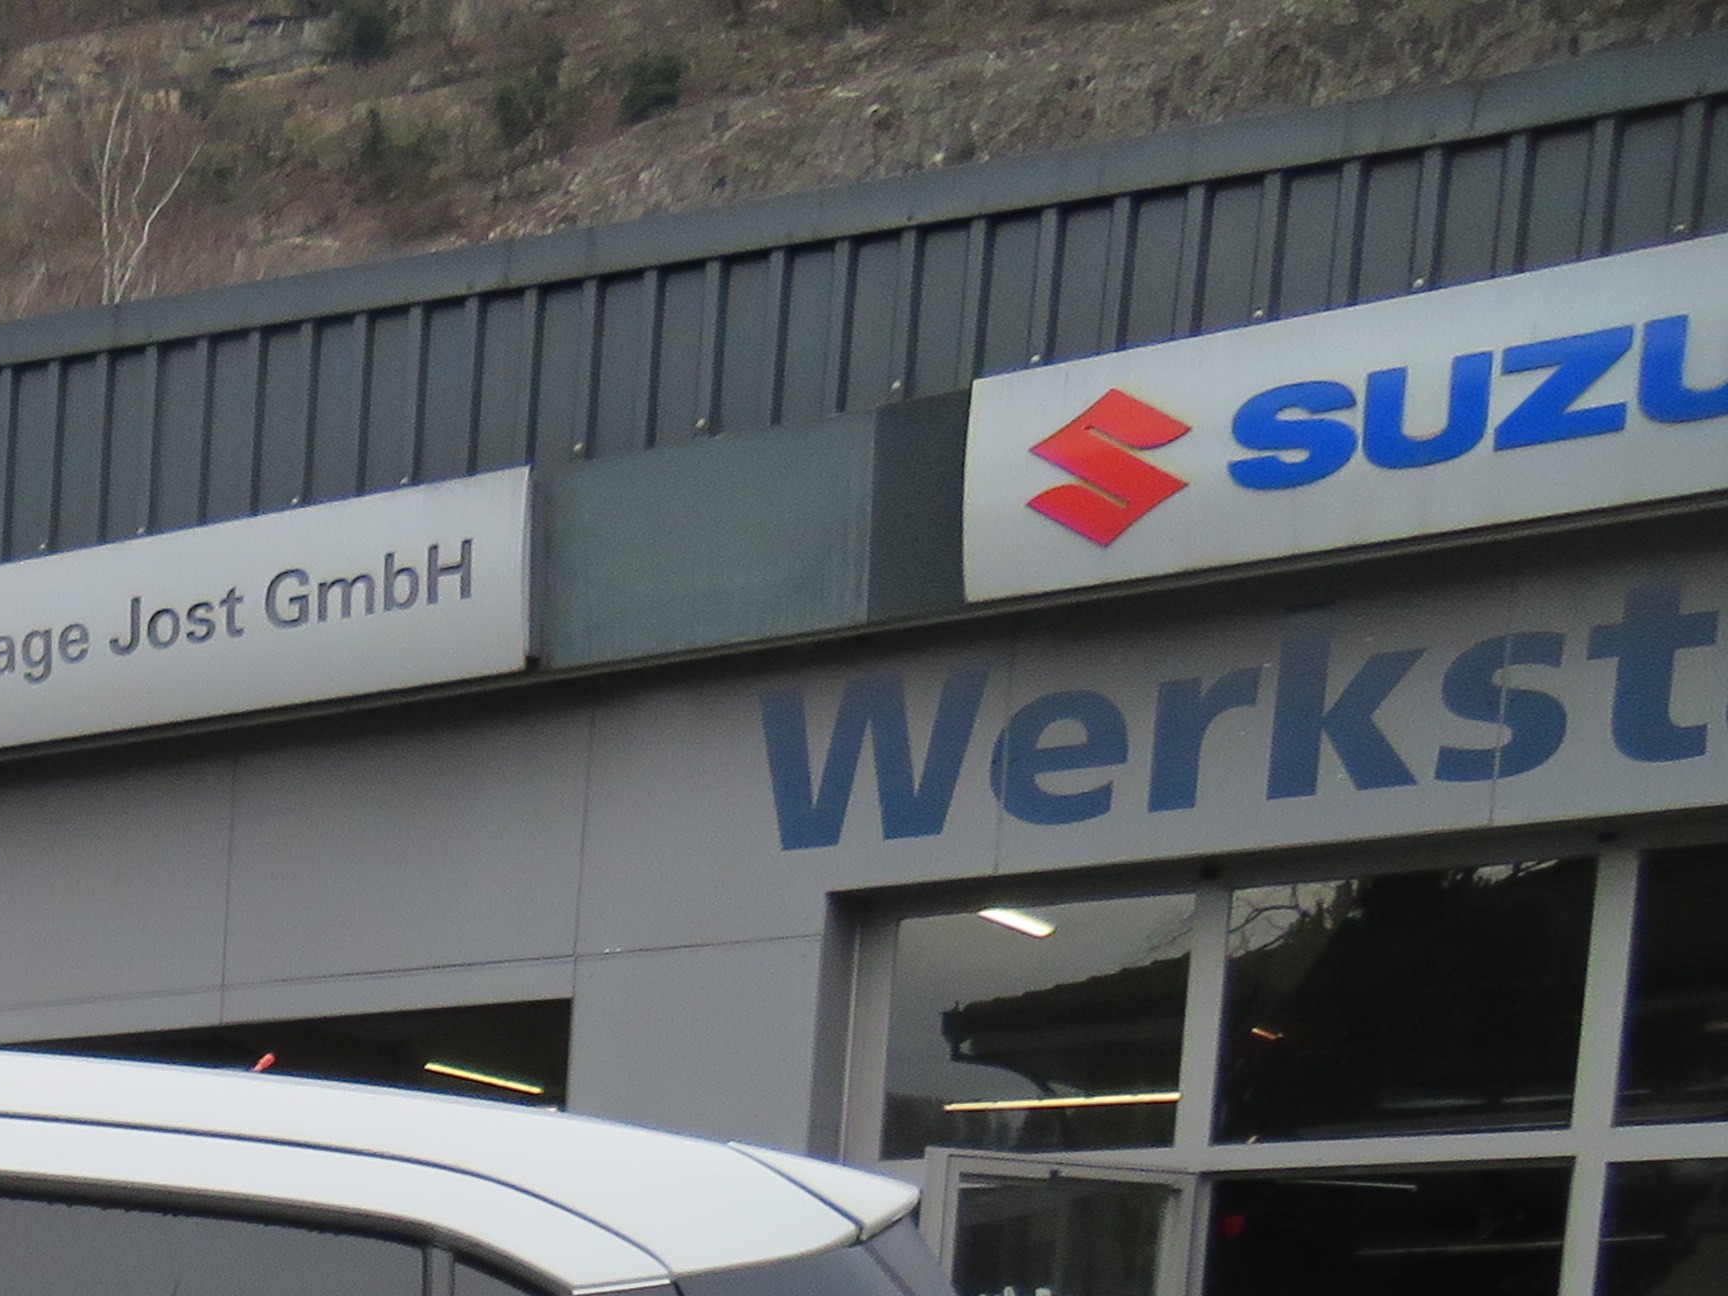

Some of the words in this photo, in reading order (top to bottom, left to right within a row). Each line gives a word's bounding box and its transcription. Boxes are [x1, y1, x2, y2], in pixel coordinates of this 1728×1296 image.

[108, 587, 245, 656] Jost
[265, 537, 474, 631] GmbH
[758, 572, 1728, 852] Werkst
